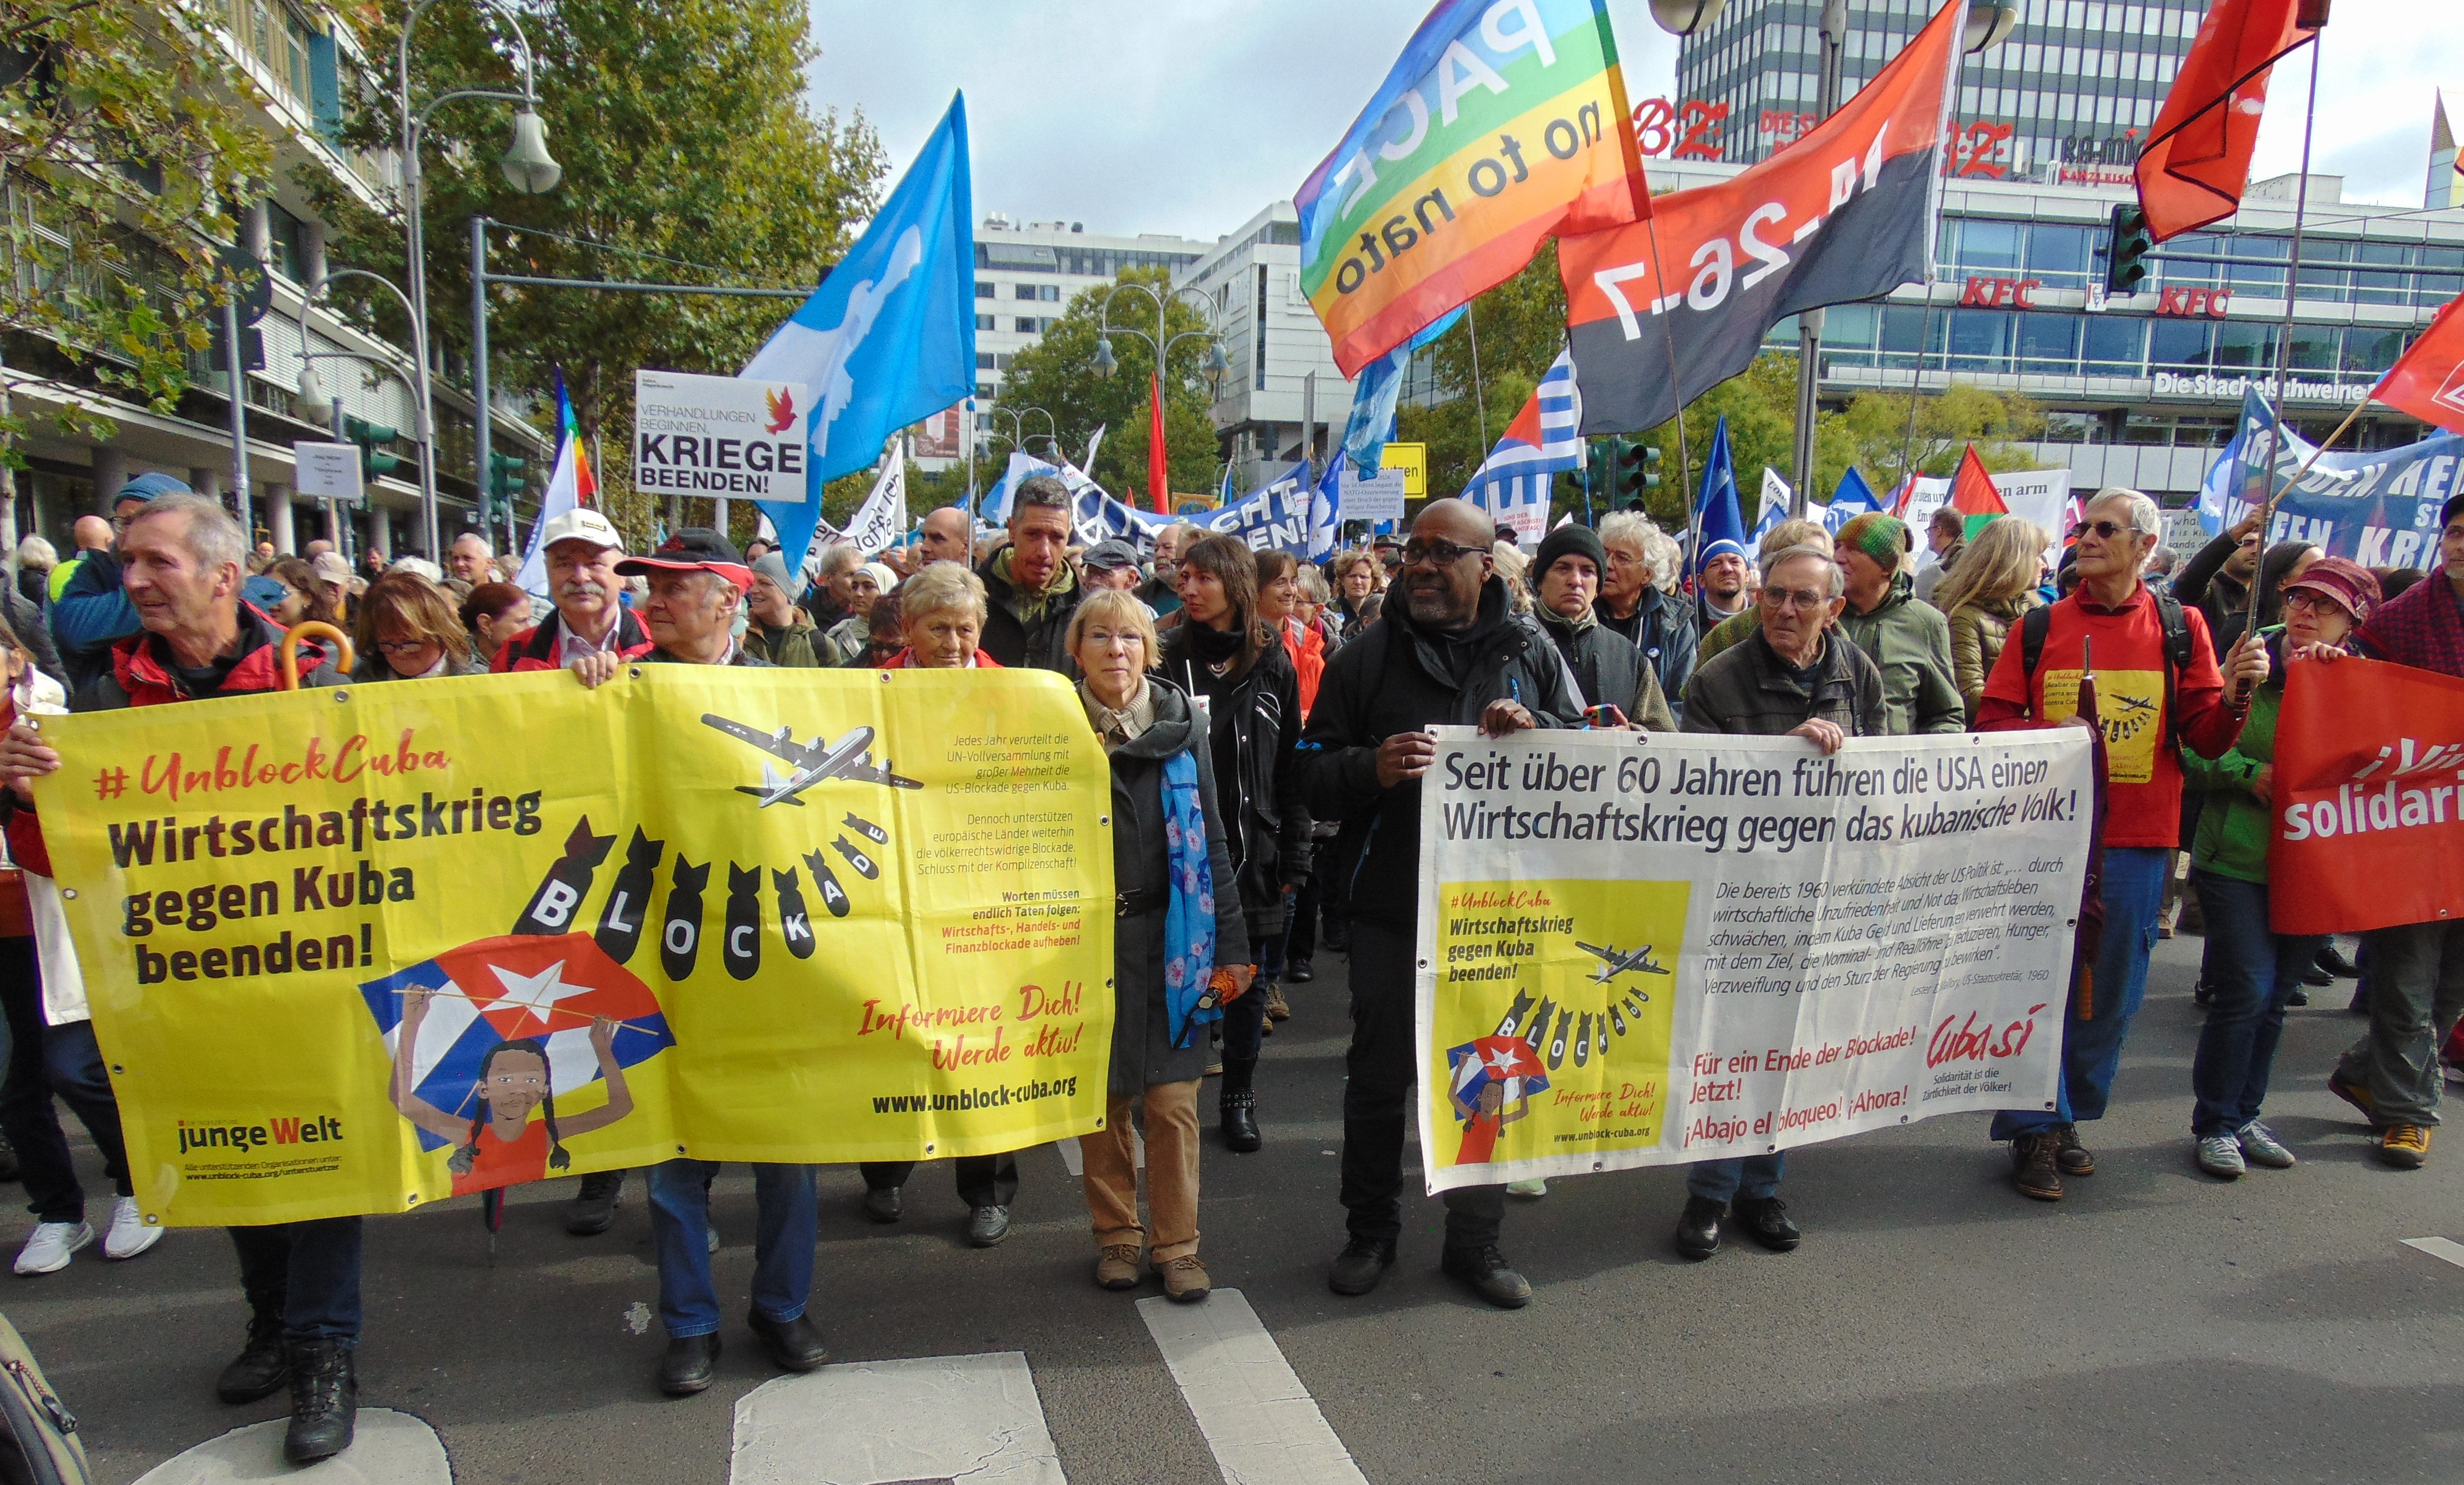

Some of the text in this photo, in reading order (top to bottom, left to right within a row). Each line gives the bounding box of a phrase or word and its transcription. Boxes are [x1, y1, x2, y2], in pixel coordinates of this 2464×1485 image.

[1760, 109, 1794, 135] DIE
[1959, 275, 2039, 309] KFC
[2155, 285, 2232, 318] KFC
[2153, 372, 2193, 393] Die
[640, 404, 755, 423] VERHANDLUNGEN
[641, 418, 709, 435] BEGINNEN,
[641, 432, 802, 474] KRIEGE
[641, 467, 769, 493] BEENDEN!
[2016, 483, 2047, 496] arm
[954, 733, 1069, 746] Jedes Jahr verurteilt die
[94, 728, 451, 802] #UnblockCuba
[947, 750, 1069, 762] UN-Vollversammlung mit
[976, 765, 1070, 779] großer Mehrheit die
[1445, 751, 2048, 797] Seit über 60 Jahren führen die USA einen
[946, 780, 1070, 794] US-Blockade gegen Kuba.
[967, 811, 1072, 825] Dennoch unterstützen
[1443, 787, 2077, 853] Wirtschaftskrieg gegen das kubanische Volk!
[2283, 780, 2464, 841] solidari
[107, 787, 543, 868] Wirtschaftskrieg
[933, 827, 1074, 843] europäische Länder weiterhin
[916, 842, 1075, 859] die völkerrechtswidrige Blockade.
[918, 857, 1076, 875] Schluss mit der Komplizenschaft!
[1716, 882, 1740, 899] Die
[1743, 881, 1791, 899] bereits
[1797, 882, 1828, 899] 1960
[1832, 878, 1896, 896] verkündete
[1897, 872, 1932, 891] Absicht
[1932, 868, 1949, 885] der
[2028, 857, 2063, 873] durch
[121, 860, 416, 936] gegen Kuba
[531, 826, 884, 958] BLOCKADE
[1002, 890, 1079, 902] Worten müssen
[1451, 890, 1552, 911] #UnblockCuba
[1714, 879, 2038, 922] wirtschaftliche Unzufriedenheit und Not Wirtschaftsleben
[973, 904, 1080, 920] endlich Taten folgen:
[1707, 929, 1787, 948] schwächen,
[1794, 929, 1831, 945] indem
[1834, 924, 1863, 943] Kuba
[1892, 917, 1912, 935] und
[1965, 905, 2006, 920] verwehrt
[2009, 900, 2055, 917] werden,
[942, 918, 1080, 938] Wirtschafts-, Handels- und
[1450, 915, 1574, 936] Wirtschaftskrieg
[137, 922, 373, 985] beenden!
[945, 935, 1080, 954] Finanzblockade aufheben!
[1447, 940, 1534, 963] gegen Kuba
[1704, 953, 1727, 971] mit
[1731, 953, 1762, 970] dem
[1766, 952, 1794, 971] Ziel,
[1800, 952, 1820, 970] die
[1822, 945, 1872, 967] Nominal-
[1894, 938, 1943, 956] Reallöhne
[2005, 923, 2050, 941] Hunger,
[1449, 963, 1518, 982] beenden!
[1705, 975, 1791, 996] Verzweiflung
[1795, 974, 1821, 993] und
[1821, 972, 1841, 990] den
[1843, 970, 1872, 986] Sturz
[1872, 964, 1890, 981] der
[1892, 958, 1942, 976] Regierung
[1911, 985, 1930, 996] Lester
[2027, 970, 2049, 980] 1960
[857, 980, 1082, 1040] Informiere Dich!
[1498, 993, 1647, 1057] BLOCKADE
[933, 1022, 1083, 1071] Werde aktiv!
[1693, 1025, 1917, 1078] Für ein Ende der Blockade!
[1933, 1070, 1972, 1085] Solidarität
[1984, 1067, 1999, 1078] die
[873, 1076, 1077, 1113] www.unblock-cuba.org
[1553, 1081, 1656, 1107] Informiere Dich!
[1689, 1078, 1742, 1105] Jetzt!
[1922, 1081, 2012, 1101] Zärtlichkeit der Völker!
[1580, 1102, 1654, 1122] Werde aktiv!
[1684, 1085, 1908, 1147] ¡Abajo el bloqueo! ¡Ahora!
[1554, 1127, 1650, 1143] www.unblock-cuba.org
[261, 1157, 319, 1169] Organisationen
